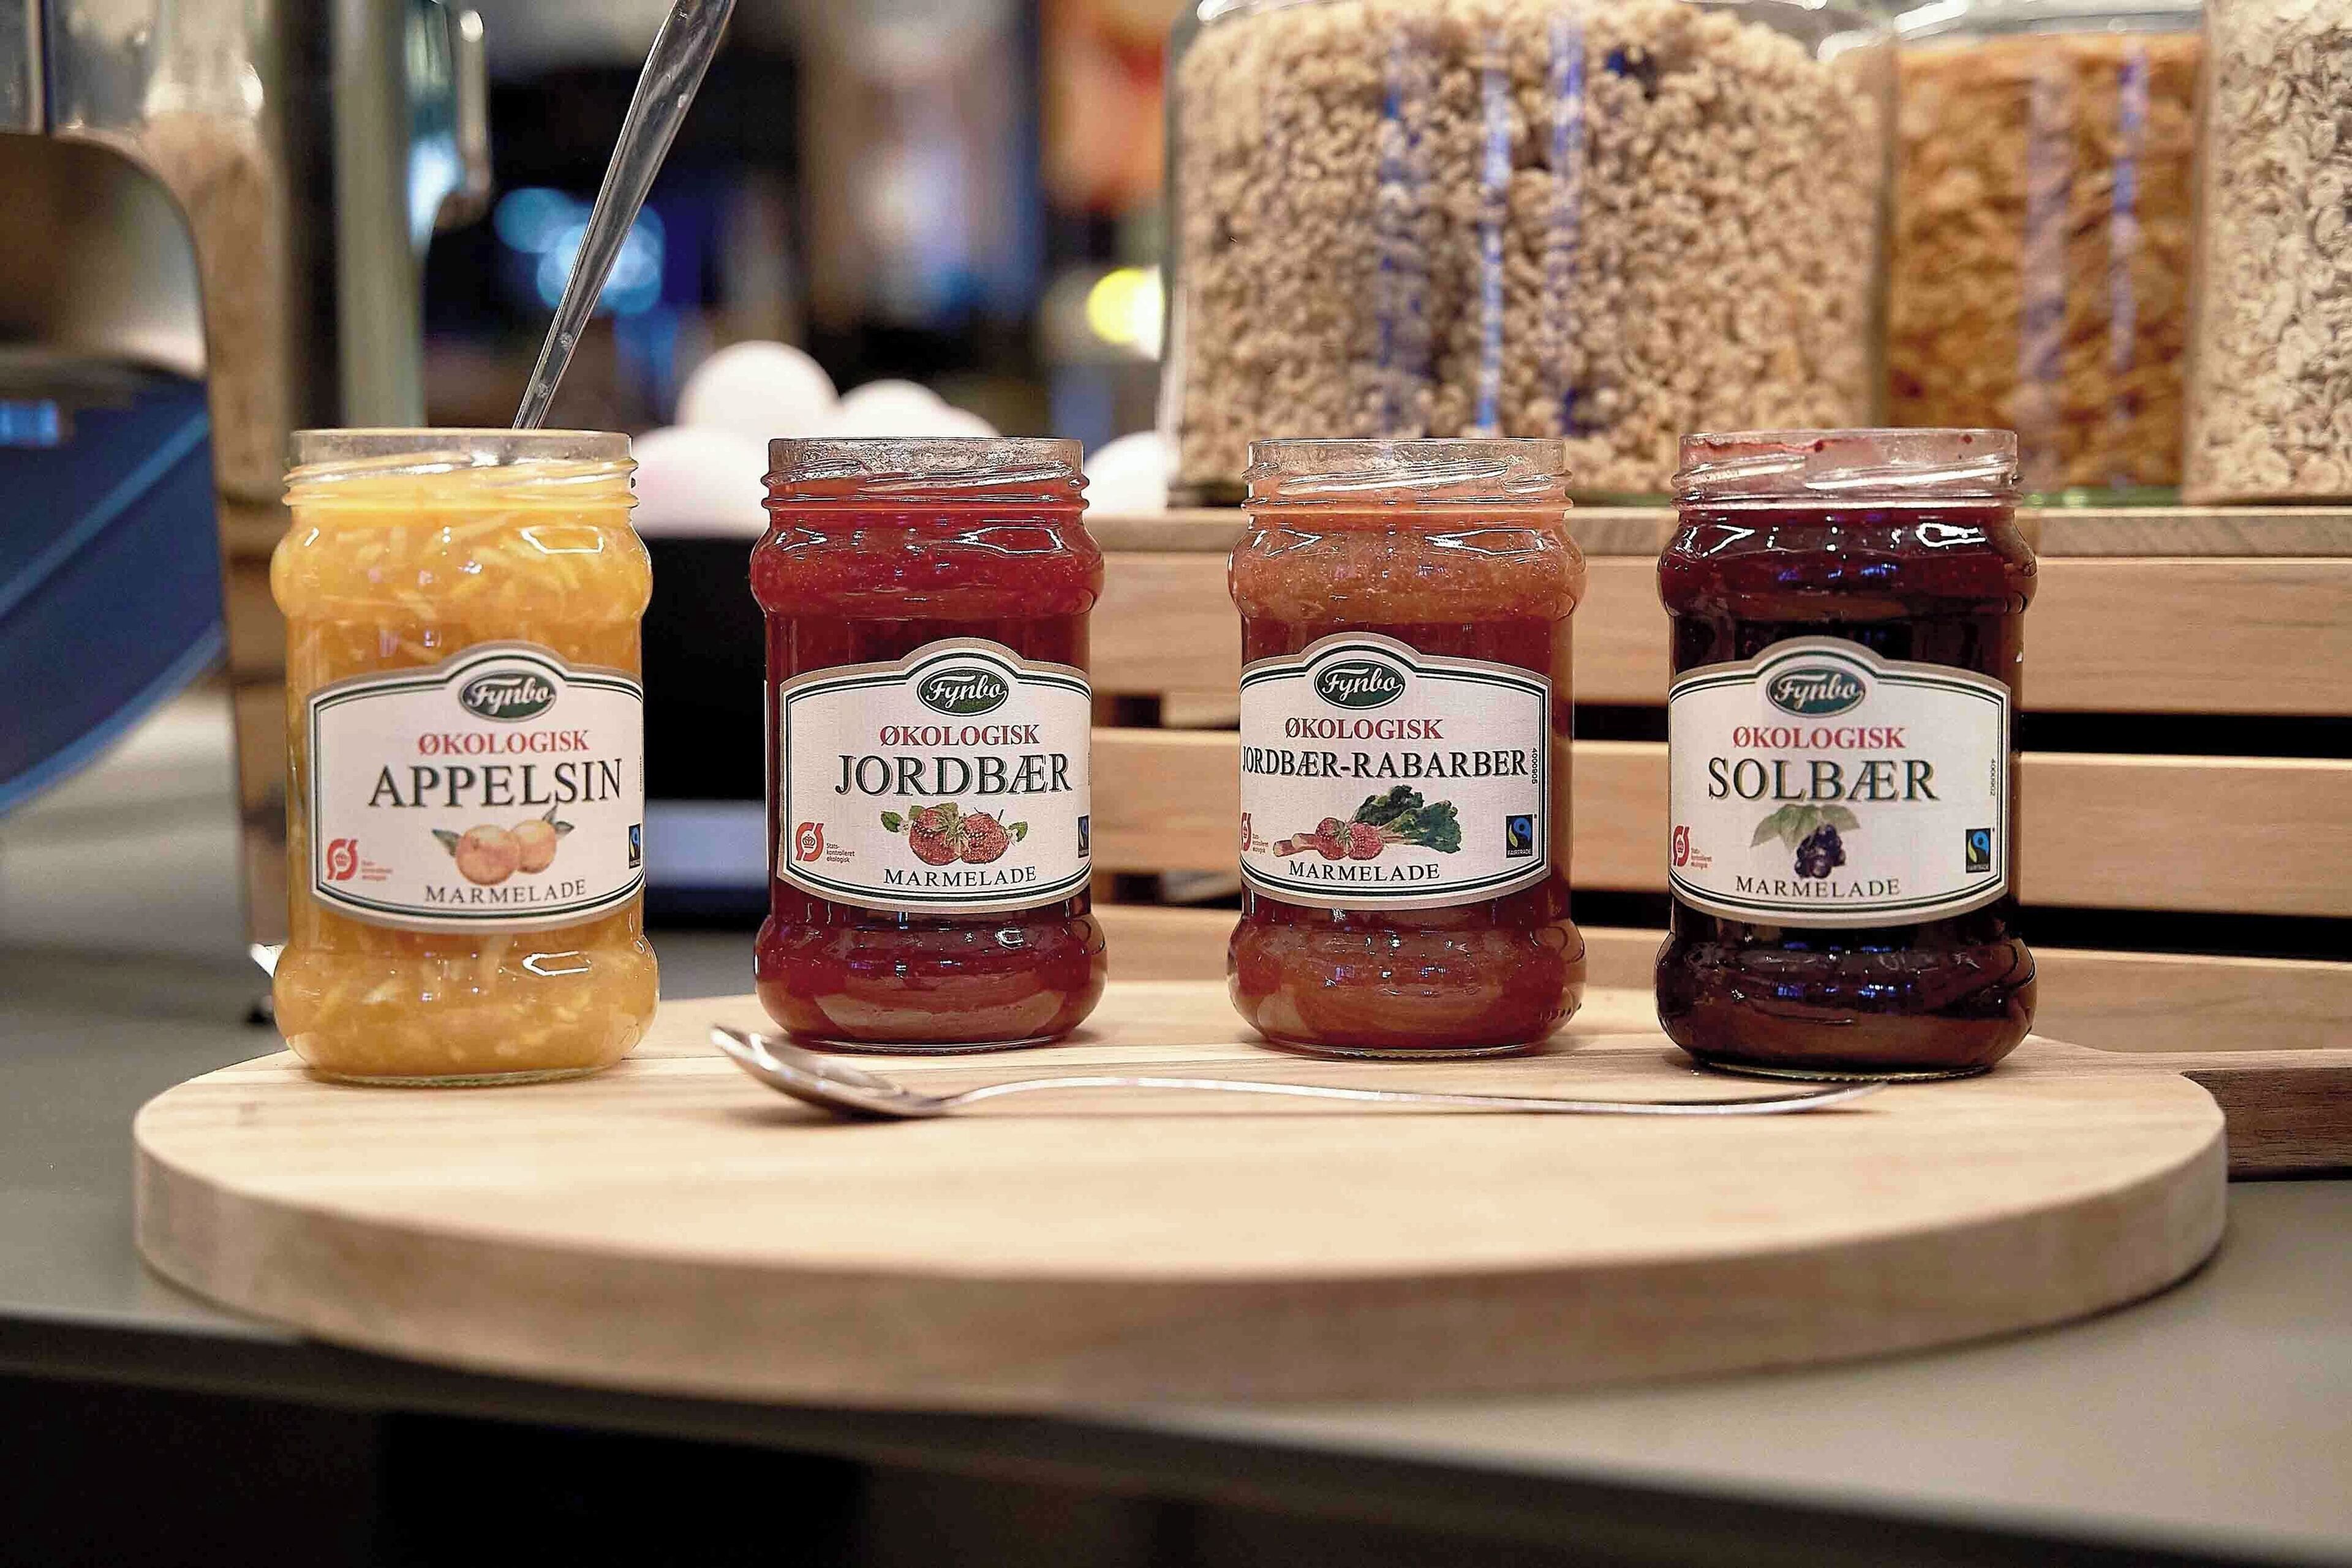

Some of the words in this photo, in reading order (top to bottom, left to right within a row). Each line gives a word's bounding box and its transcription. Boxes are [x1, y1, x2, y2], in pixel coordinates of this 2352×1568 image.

[467, 677, 554, 714] Fynbo
[925, 674, 1008, 708] Fynbo
[1322, 668, 1402, 702] Fynbo
[1774, 674, 1863, 710] Fynbo
[880, 724, 1040, 746] ØKOLOGISK
[1285, 717, 1444, 739] ØKOLOGISK
[1733, 726, 1905, 749] ØKOLOGISK
[418, 730, 589, 755] ØKOLOGISK
[369, 758, 622, 808] APPELSIN
[835, 754, 1072, 796] JORDBÆR
[1709, 756, 1940, 802] SOLBÆR
[883, 865, 1037, 887] MARMELADE
[1289, 859, 1440, 881] MARMELADE
[426, 879, 586, 904] MARMELADE
[1735, 875, 1901, 899] MARMELADE
